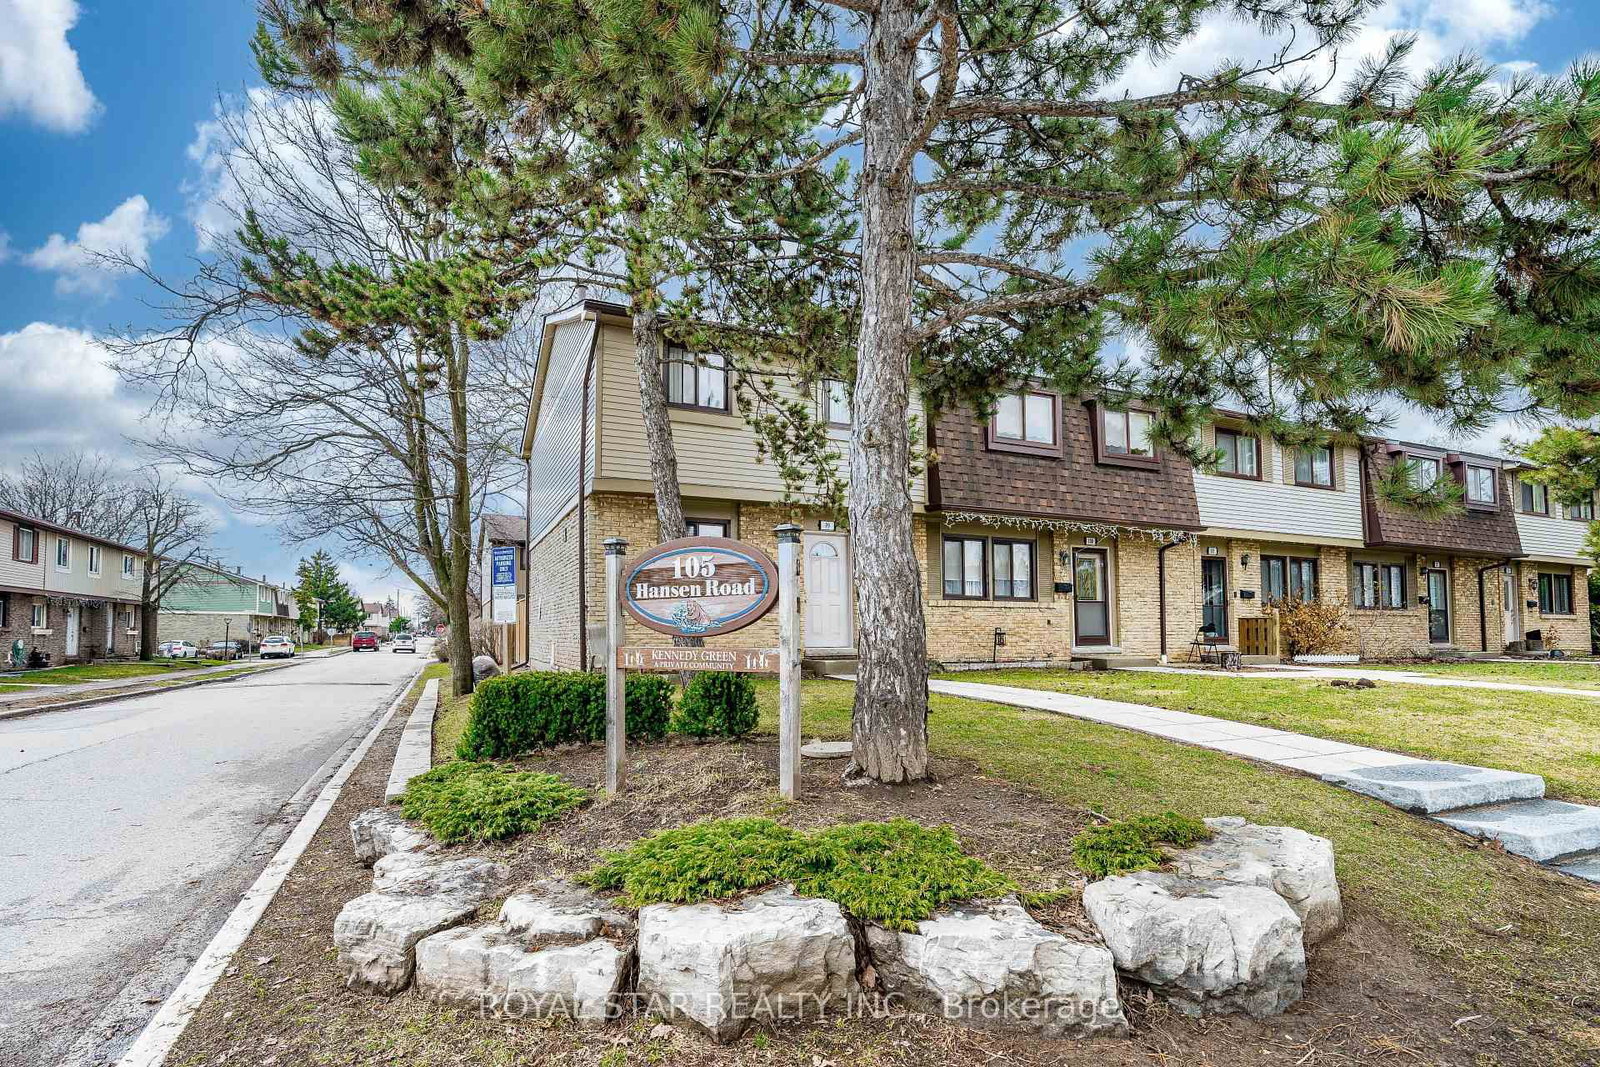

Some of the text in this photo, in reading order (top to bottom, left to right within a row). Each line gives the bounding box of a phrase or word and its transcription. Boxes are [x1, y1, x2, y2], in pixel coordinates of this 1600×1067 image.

[671, 555, 716, 579] 105
[636, 578, 756, 599] Hansen Road
[652, 650, 737, 662] KENNEDY GREEN
[661, 661, 688, 669] PRIVATE
[689, 662, 735, 670] COMMUNITY
